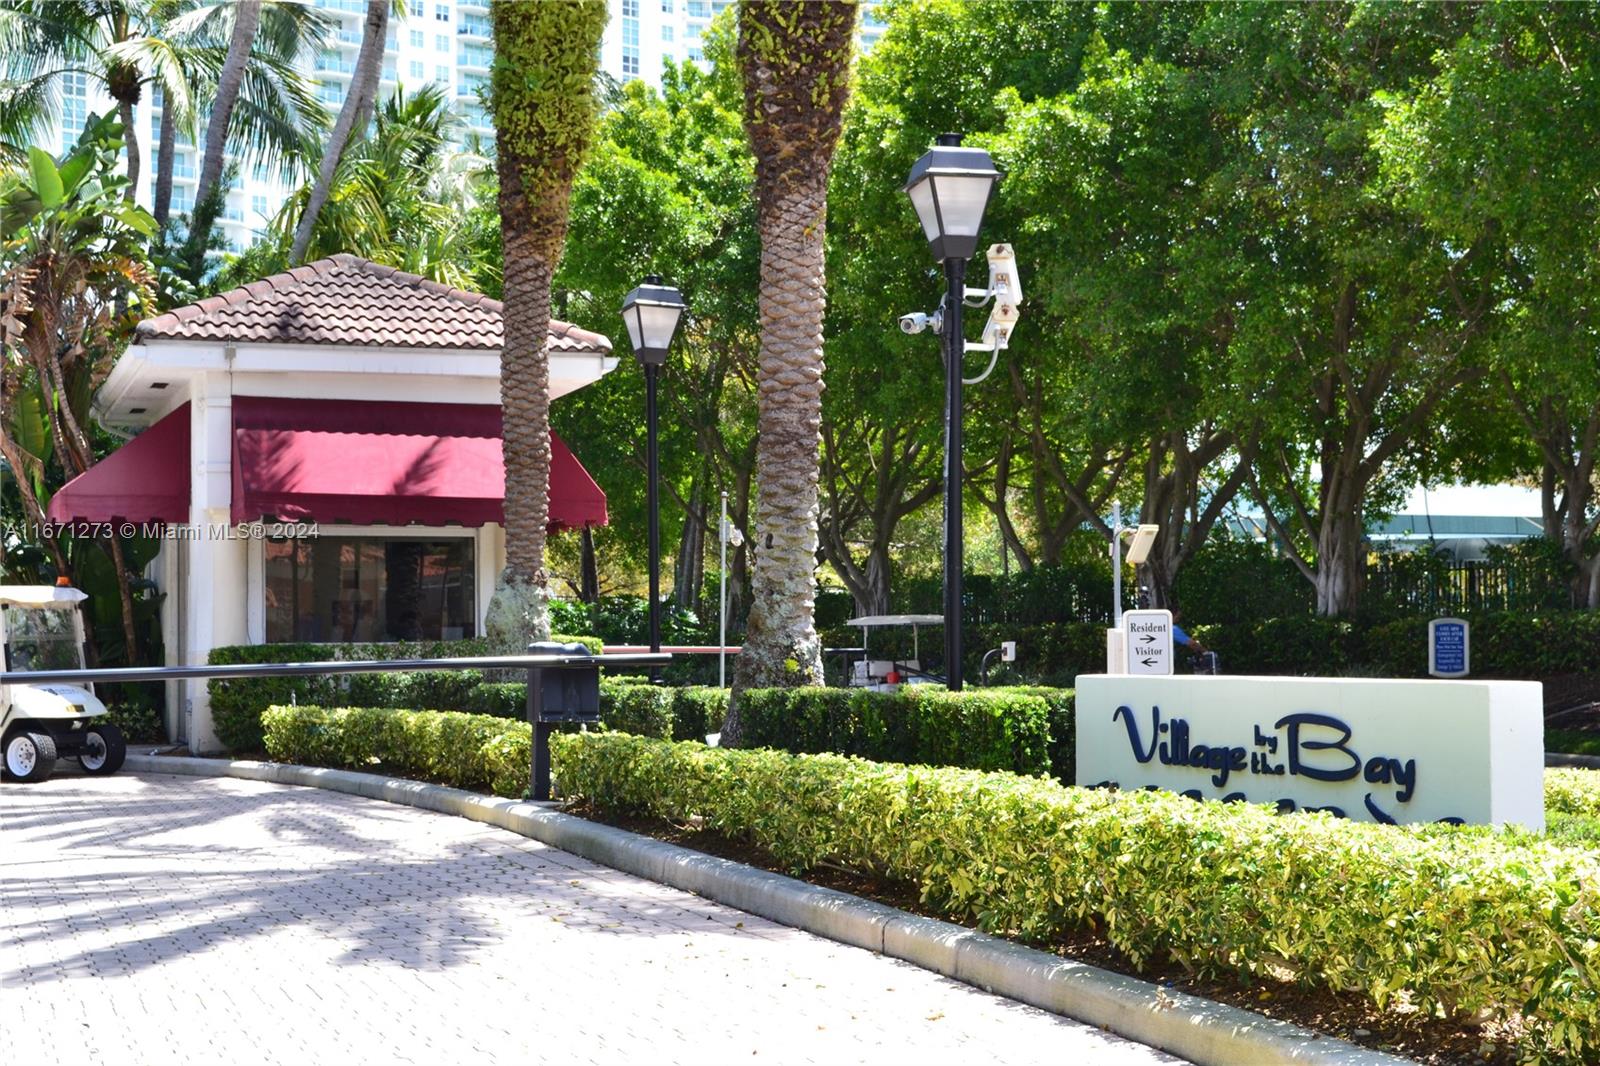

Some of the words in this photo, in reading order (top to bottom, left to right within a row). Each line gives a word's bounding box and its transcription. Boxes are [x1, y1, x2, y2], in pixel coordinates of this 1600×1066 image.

[1130, 622, 1166, 632] Resident
[1135, 646, 1162, 656] Visitor
[1112, 705, 1248, 788] Village
[1254, 725, 1278, 754] by
[1251, 752, 1285, 775] the
[1274, 713, 1416, 803] Bay
